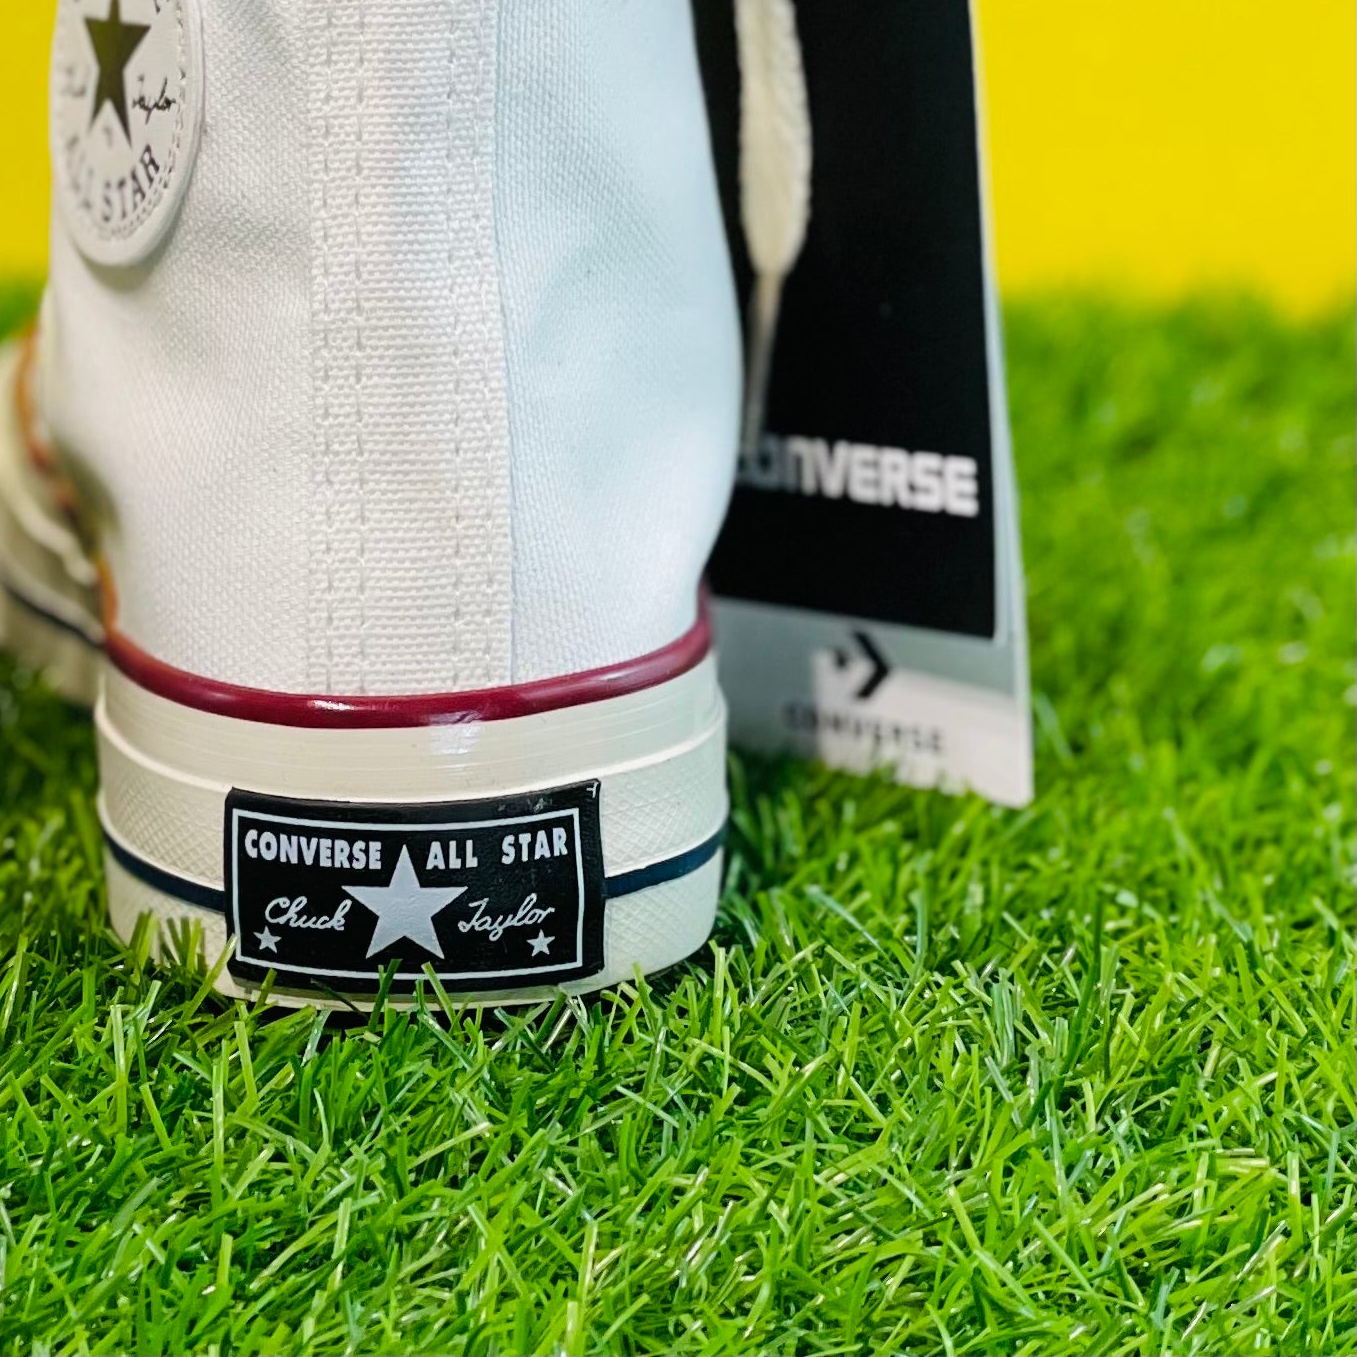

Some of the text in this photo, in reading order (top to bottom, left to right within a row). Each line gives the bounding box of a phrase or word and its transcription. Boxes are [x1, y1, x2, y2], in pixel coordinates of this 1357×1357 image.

[101, 143, 161, 223] STAR
[244, 827, 568, 870] CONVERSE ALL STAR
[264, 892, 555, 942] Chuck Taylor
